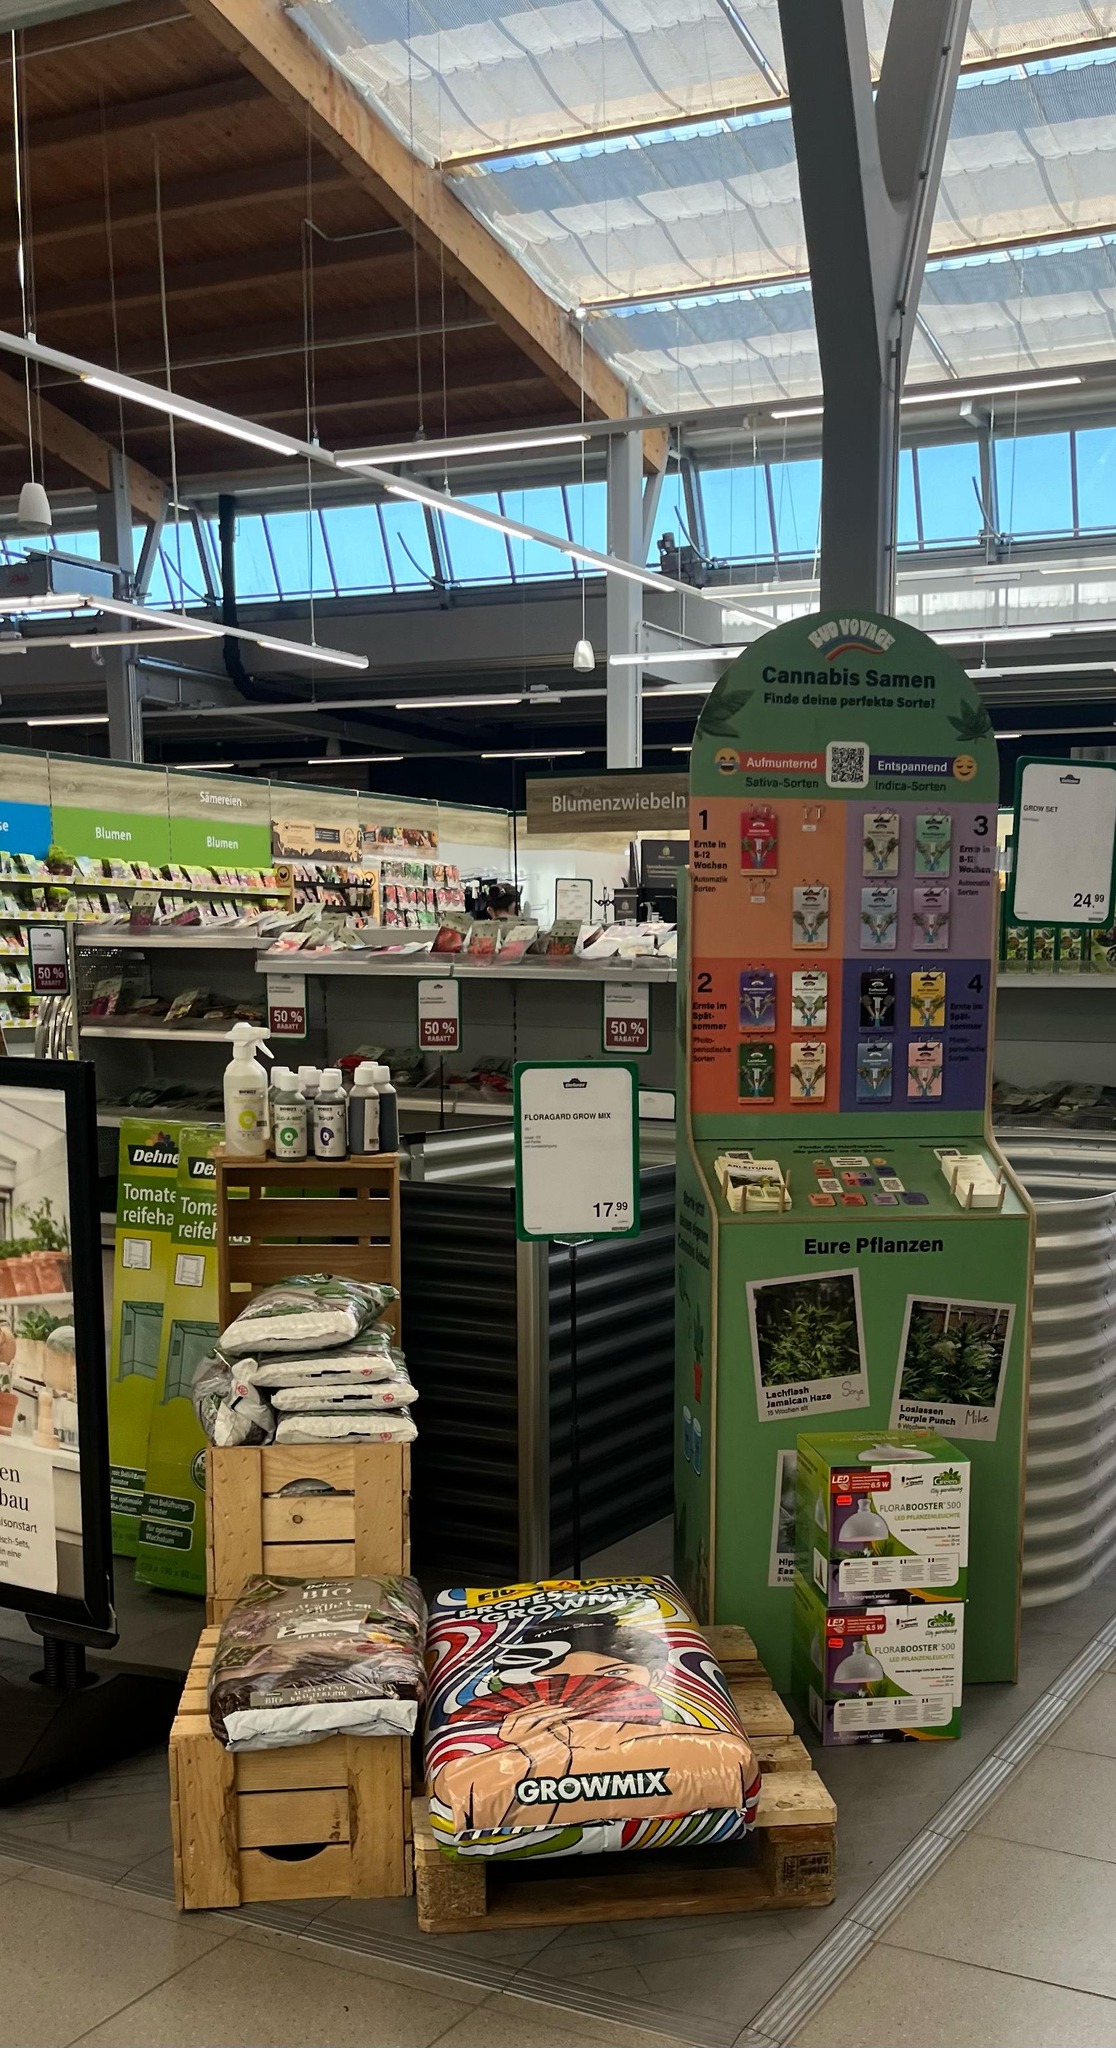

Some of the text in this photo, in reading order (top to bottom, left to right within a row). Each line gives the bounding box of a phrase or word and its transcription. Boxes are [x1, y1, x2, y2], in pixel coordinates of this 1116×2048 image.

[762, 666, 936, 688] Cannabis Samen
[764, 693, 935, 708] Finde deine perfekte Sorte!
[746, 757, 817, 770] Aufmunternd
[878, 760, 947, 773] Entspannend
[746, 777, 819, 788] Sativa-Sorten
[875, 780, 946, 792] Indica-Sorten
[200, 791, 242, 807] Sämereien
[552, 792, 686, 812] Blumenzwiebeln
[699, 809, 708, 830] 1
[974, 815, 988, 836] 3
[95, 827, 132, 841] Blumen
[206, 836, 239, 849] Blumen
[694, 840, 726, 849] Ernte in
[694, 861, 728, 869] Wochen
[38, 967, 65, 980] 50 %
[697, 972, 713, 993] 2
[967, 974, 983, 994] 4
[274, 1010, 303, 1023] 50 %
[424, 1021, 455, 1035] 50 %
[611, 1021, 645, 1035] 50 %
[524, 1113, 571, 1121] FLORAGARD
[133, 1149, 179, 1165] Dehne
[193, 1161, 217, 1176] De
[804, 1237, 943, 1254] Eure Pflanzen
[766, 1387, 809, 1399] Lachflash
[766, 1393, 832, 1408] Jamaican Haze
[900, 1405, 943, 1416] Loslassen
[899, 1414, 956, 1426] Purple Punch
[964, 1410, 989, 1425] Mike
[832, 1475, 849, 1484] LED
[880, 1501, 961, 1513] FLORABOOSTER 500
[779, 1558, 795, 1567] Hip
[302, 1587, 352, 1600] BIO
[456, 1584, 669, 1618] PROFESSIONAL
[482, 1591, 650, 1623] GROWMIX
[827, 1618, 845, 1627] LED
[875, 1644, 938, 1654] FLORABOOSTER
[517, 1771, 667, 1803] GROWMIX
